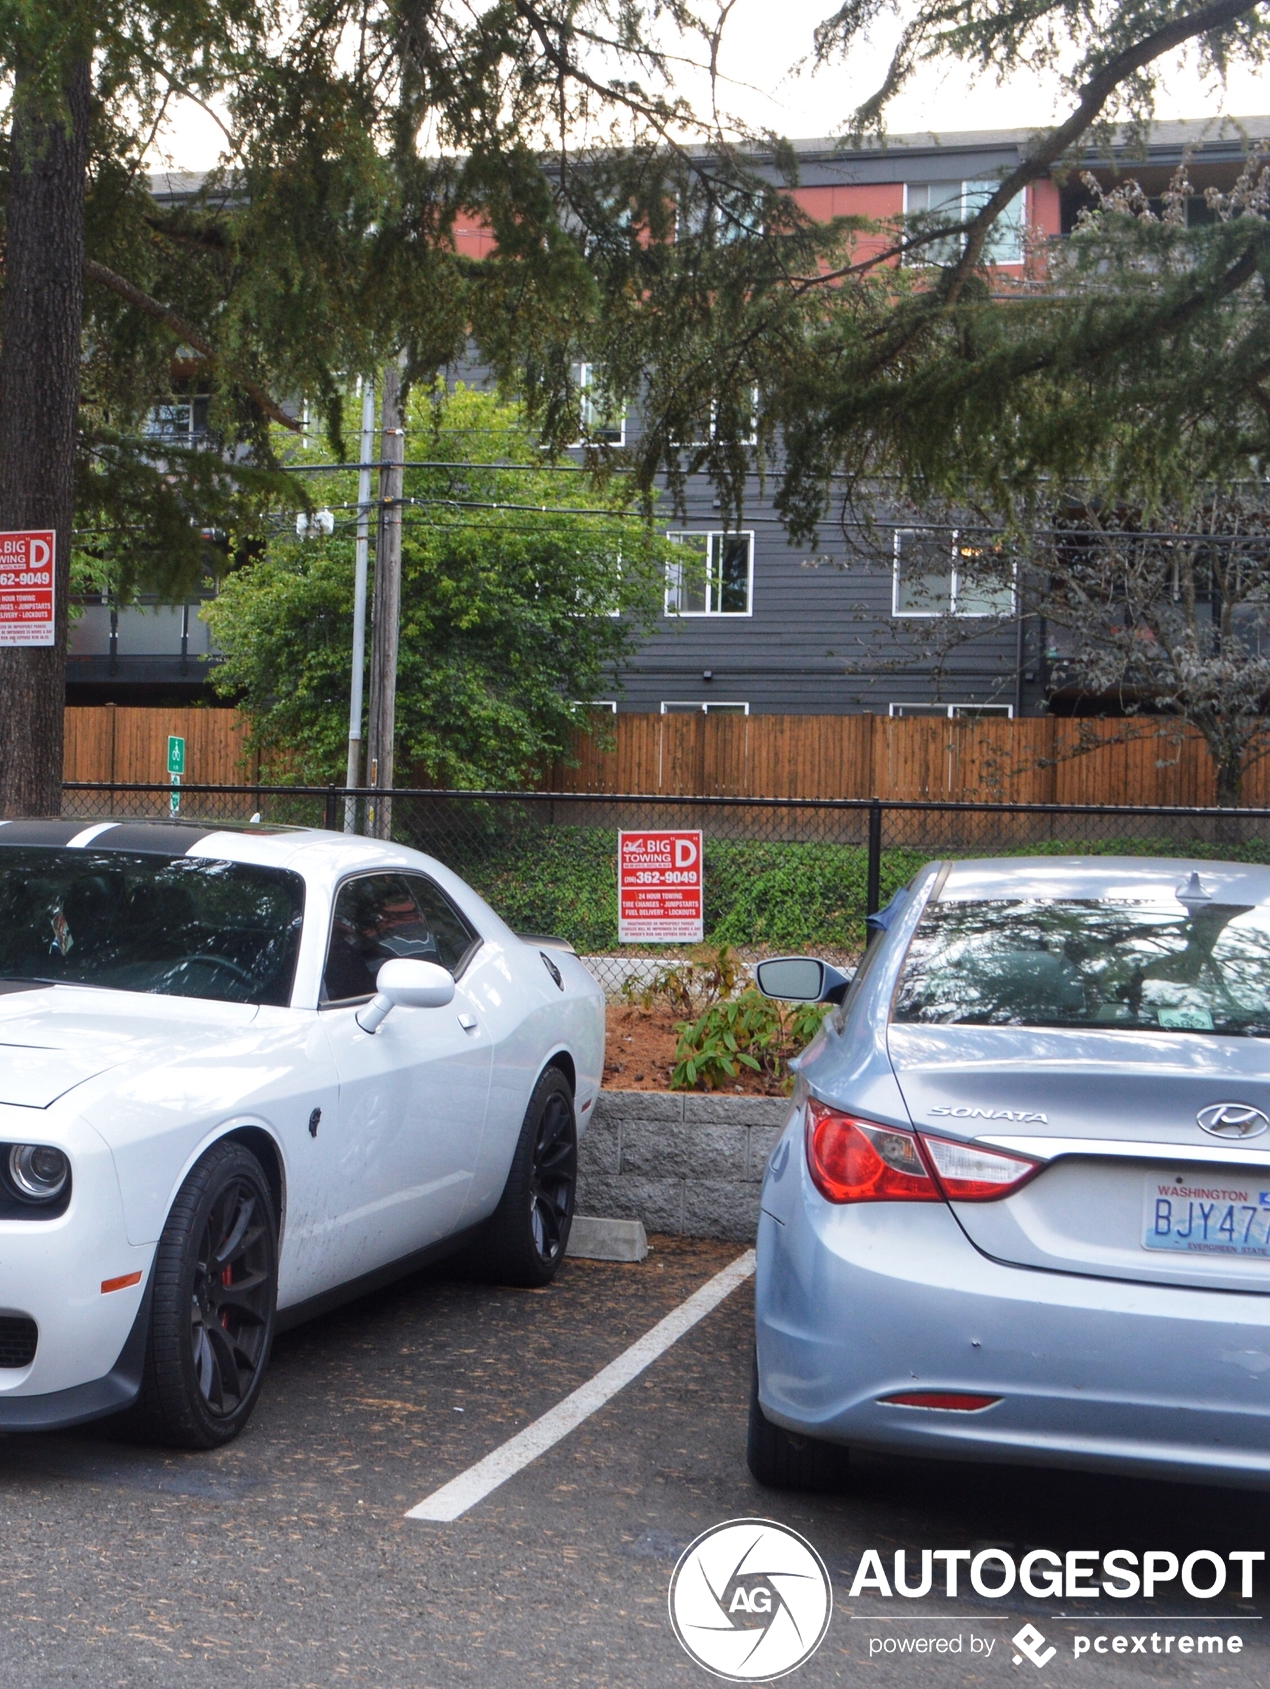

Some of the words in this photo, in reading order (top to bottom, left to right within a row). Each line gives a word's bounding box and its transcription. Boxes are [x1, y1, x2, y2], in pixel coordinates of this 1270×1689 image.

[4, 540, 26, 554] BIG
[647, 840, 670, 852] BIG
[624, 854, 671, 862] TOWING
[636, 872, 697, 884] 362-9049
[928, 1106, 1048, 1124] SONATA
[1158, 1185, 1248, 1202] WASHINGTON
[1188, 1242, 1237, 1253] EVERGREEN
[1241, 1246, 1268, 1256] STATE
